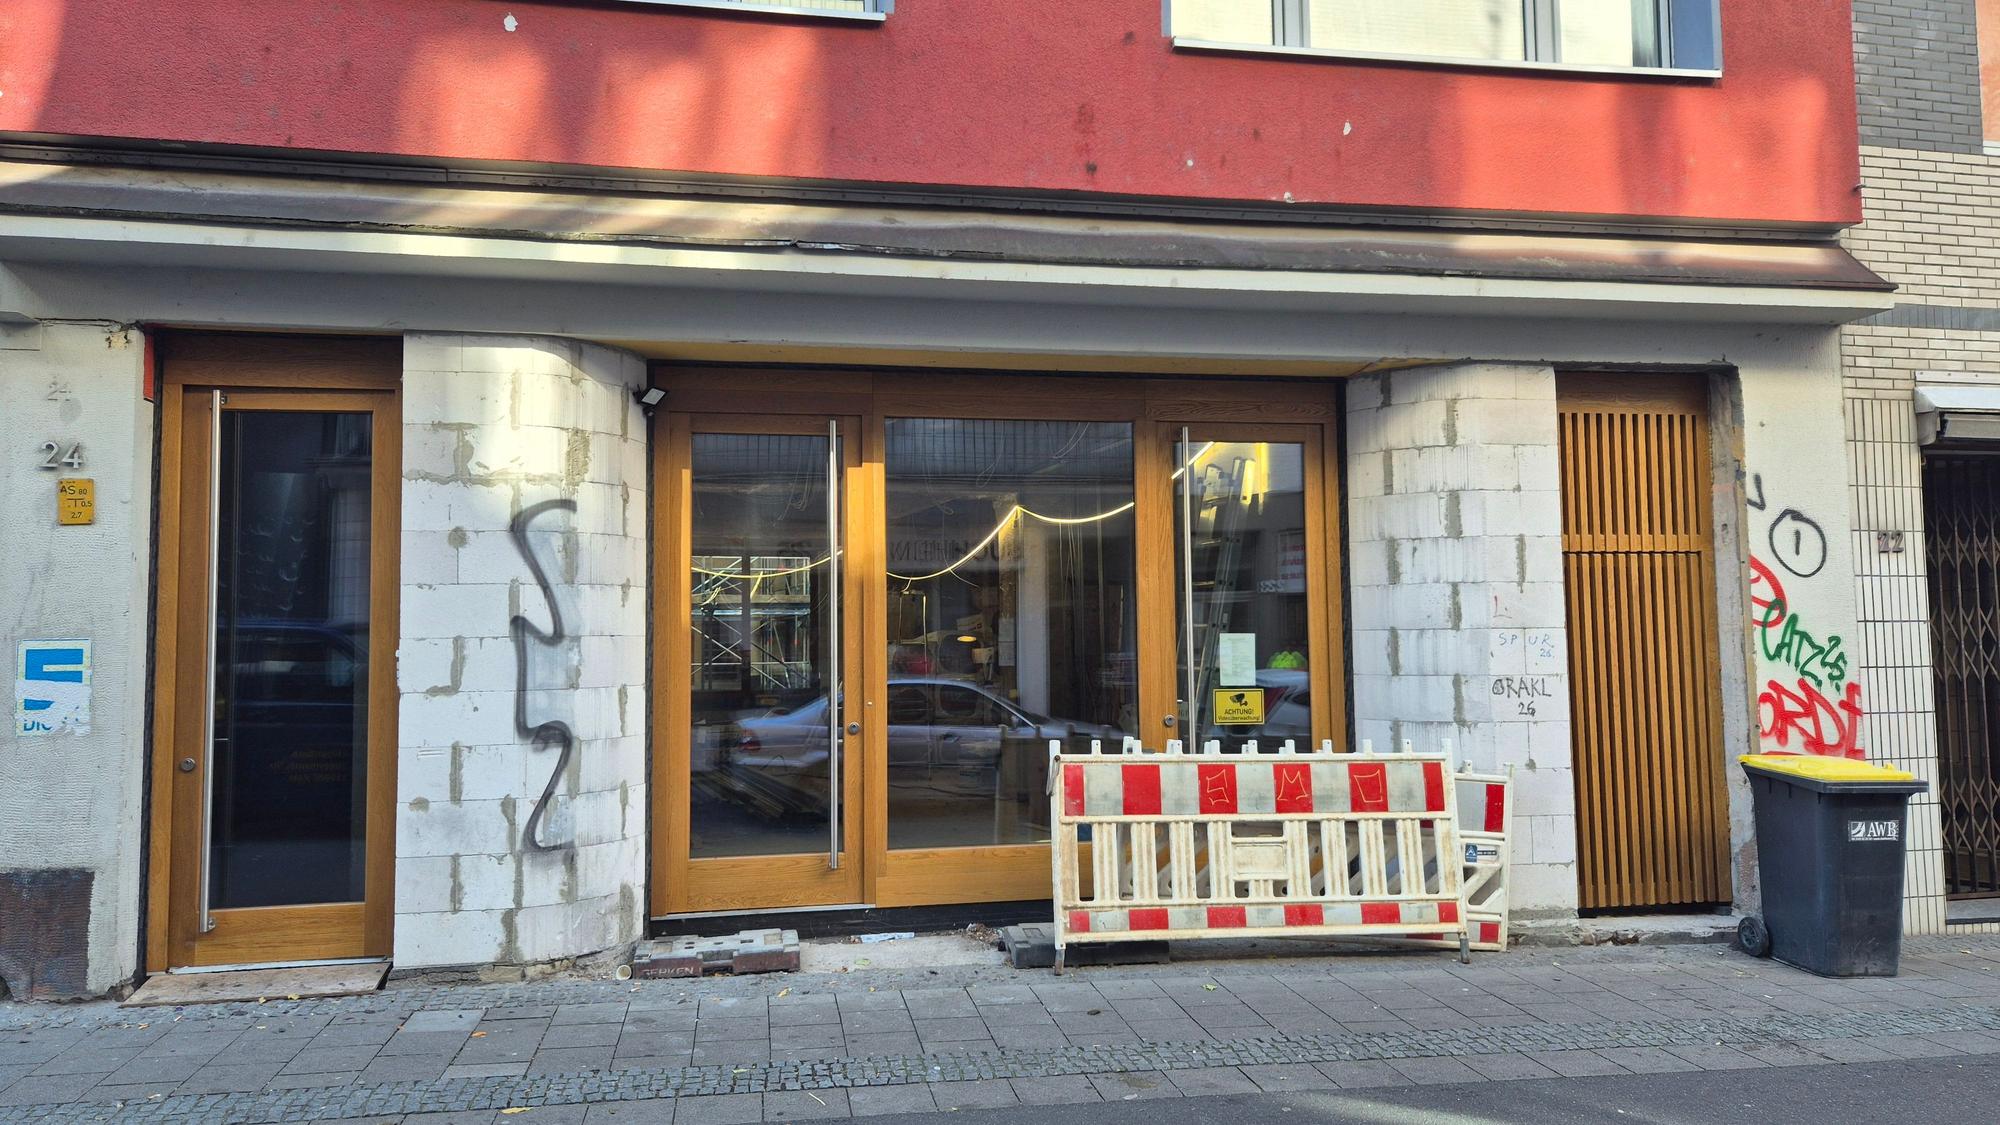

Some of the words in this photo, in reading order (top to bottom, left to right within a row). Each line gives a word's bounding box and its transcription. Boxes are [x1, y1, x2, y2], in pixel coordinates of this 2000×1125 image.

[40, 441, 83, 471] 24
[60, 485, 76, 495] AS
[1878, 531, 1904, 553] 22
[1539, 648, 1552, 658] 26
[1491, 677, 1552, 699] ORAKL
[1867, 821, 1897, 837] AWB
